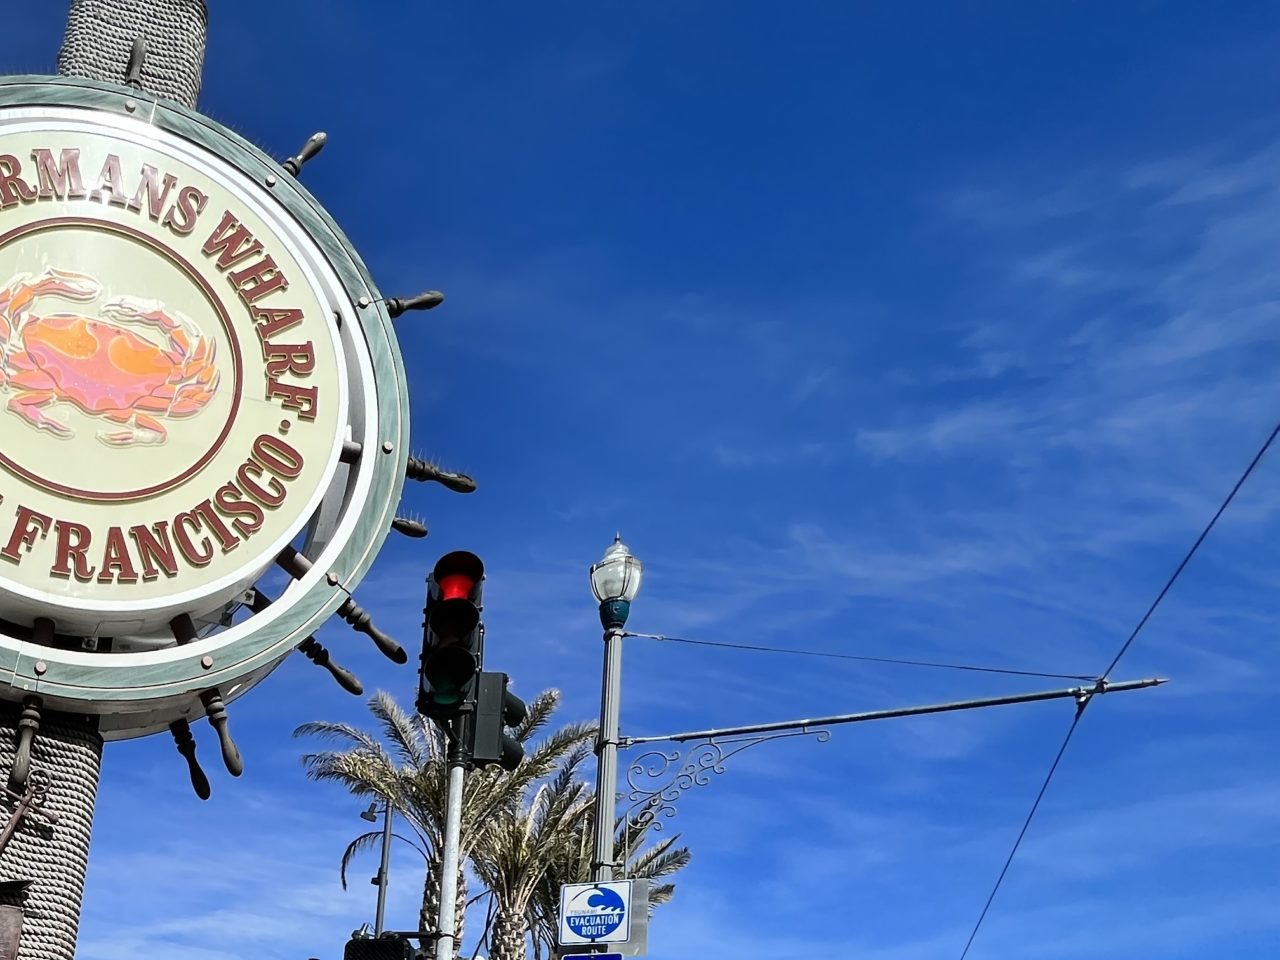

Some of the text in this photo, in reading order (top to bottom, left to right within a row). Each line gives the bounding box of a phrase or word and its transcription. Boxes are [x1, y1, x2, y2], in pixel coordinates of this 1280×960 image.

[201, 210, 319, 422] WHARF
[0, 433, 305, 584] FRANCISCO
[570, 915, 619, 926] EVACUATION
[581, 926, 606, 935] ROUTE
